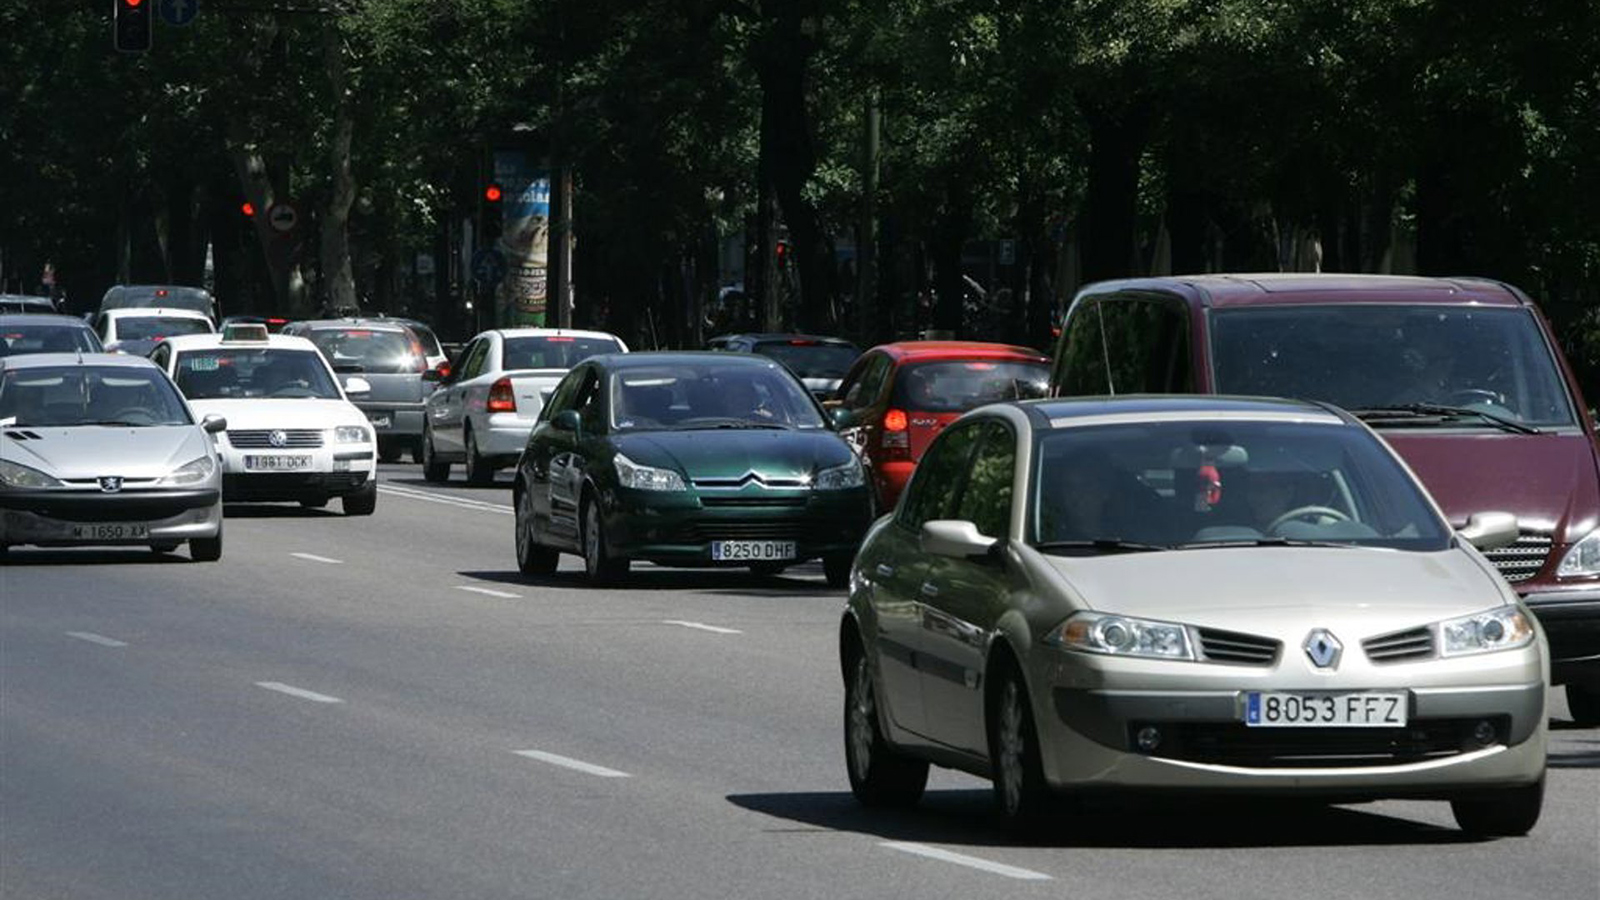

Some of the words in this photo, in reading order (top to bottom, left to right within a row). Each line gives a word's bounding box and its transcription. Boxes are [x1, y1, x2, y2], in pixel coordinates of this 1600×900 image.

[723, 543, 760, 558] 8250
[765, 543, 793, 558] DHF
[1266, 696, 1336, 722] 8053
[1347, 697, 1399, 722] FFZ
